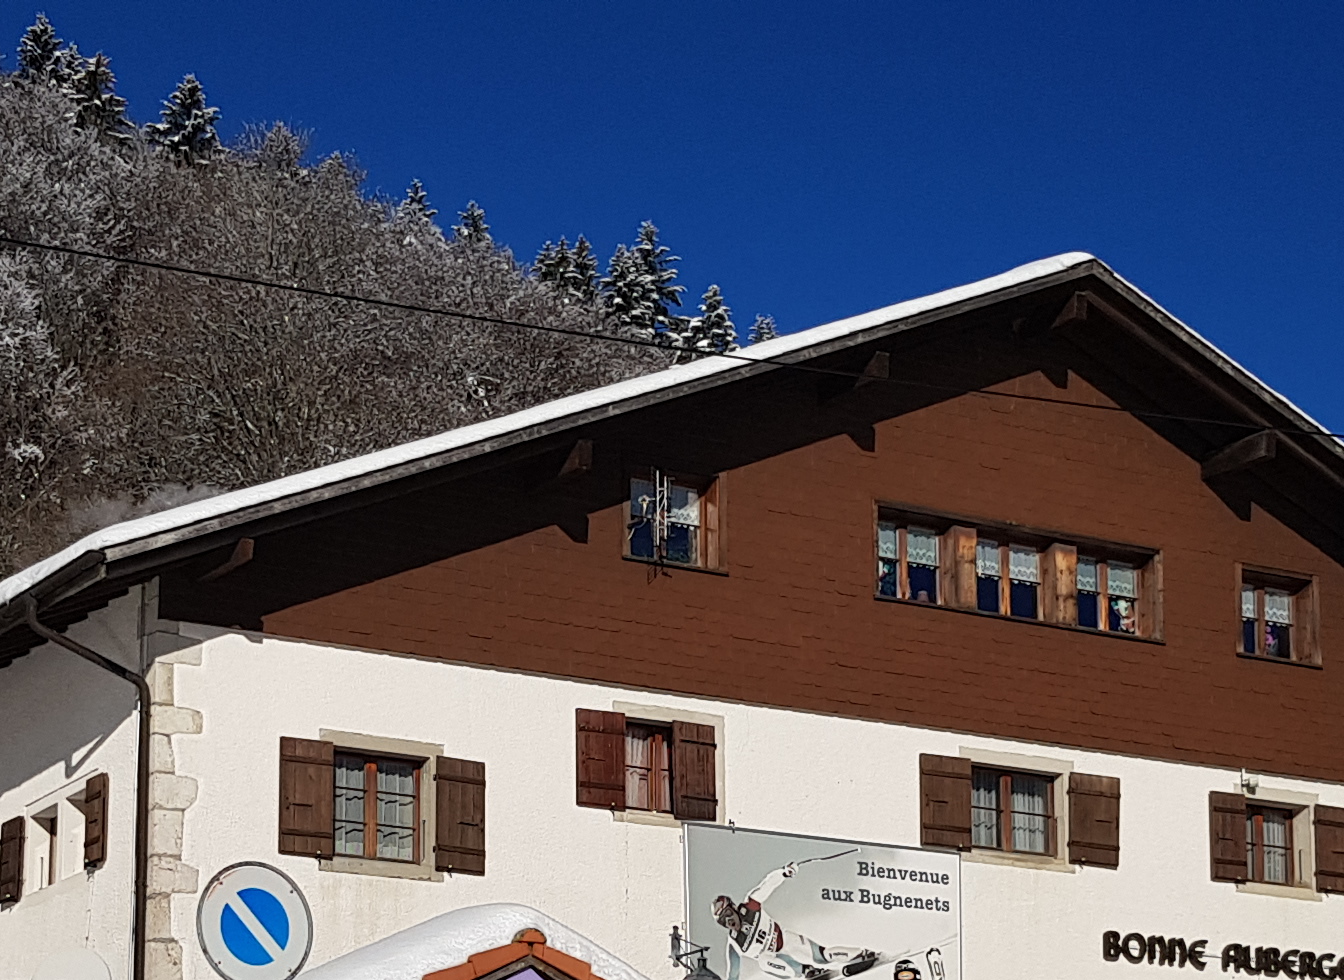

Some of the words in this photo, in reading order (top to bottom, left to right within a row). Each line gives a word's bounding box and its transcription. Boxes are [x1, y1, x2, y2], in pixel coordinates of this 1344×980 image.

[856, 861, 950, 885] Bienvenue
[821, 888, 854, 903] aux
[858, 888, 950, 912] Bugnenets
[755, 928, 767, 945] 16
[1102, 930, 1208, 971] BONNE
